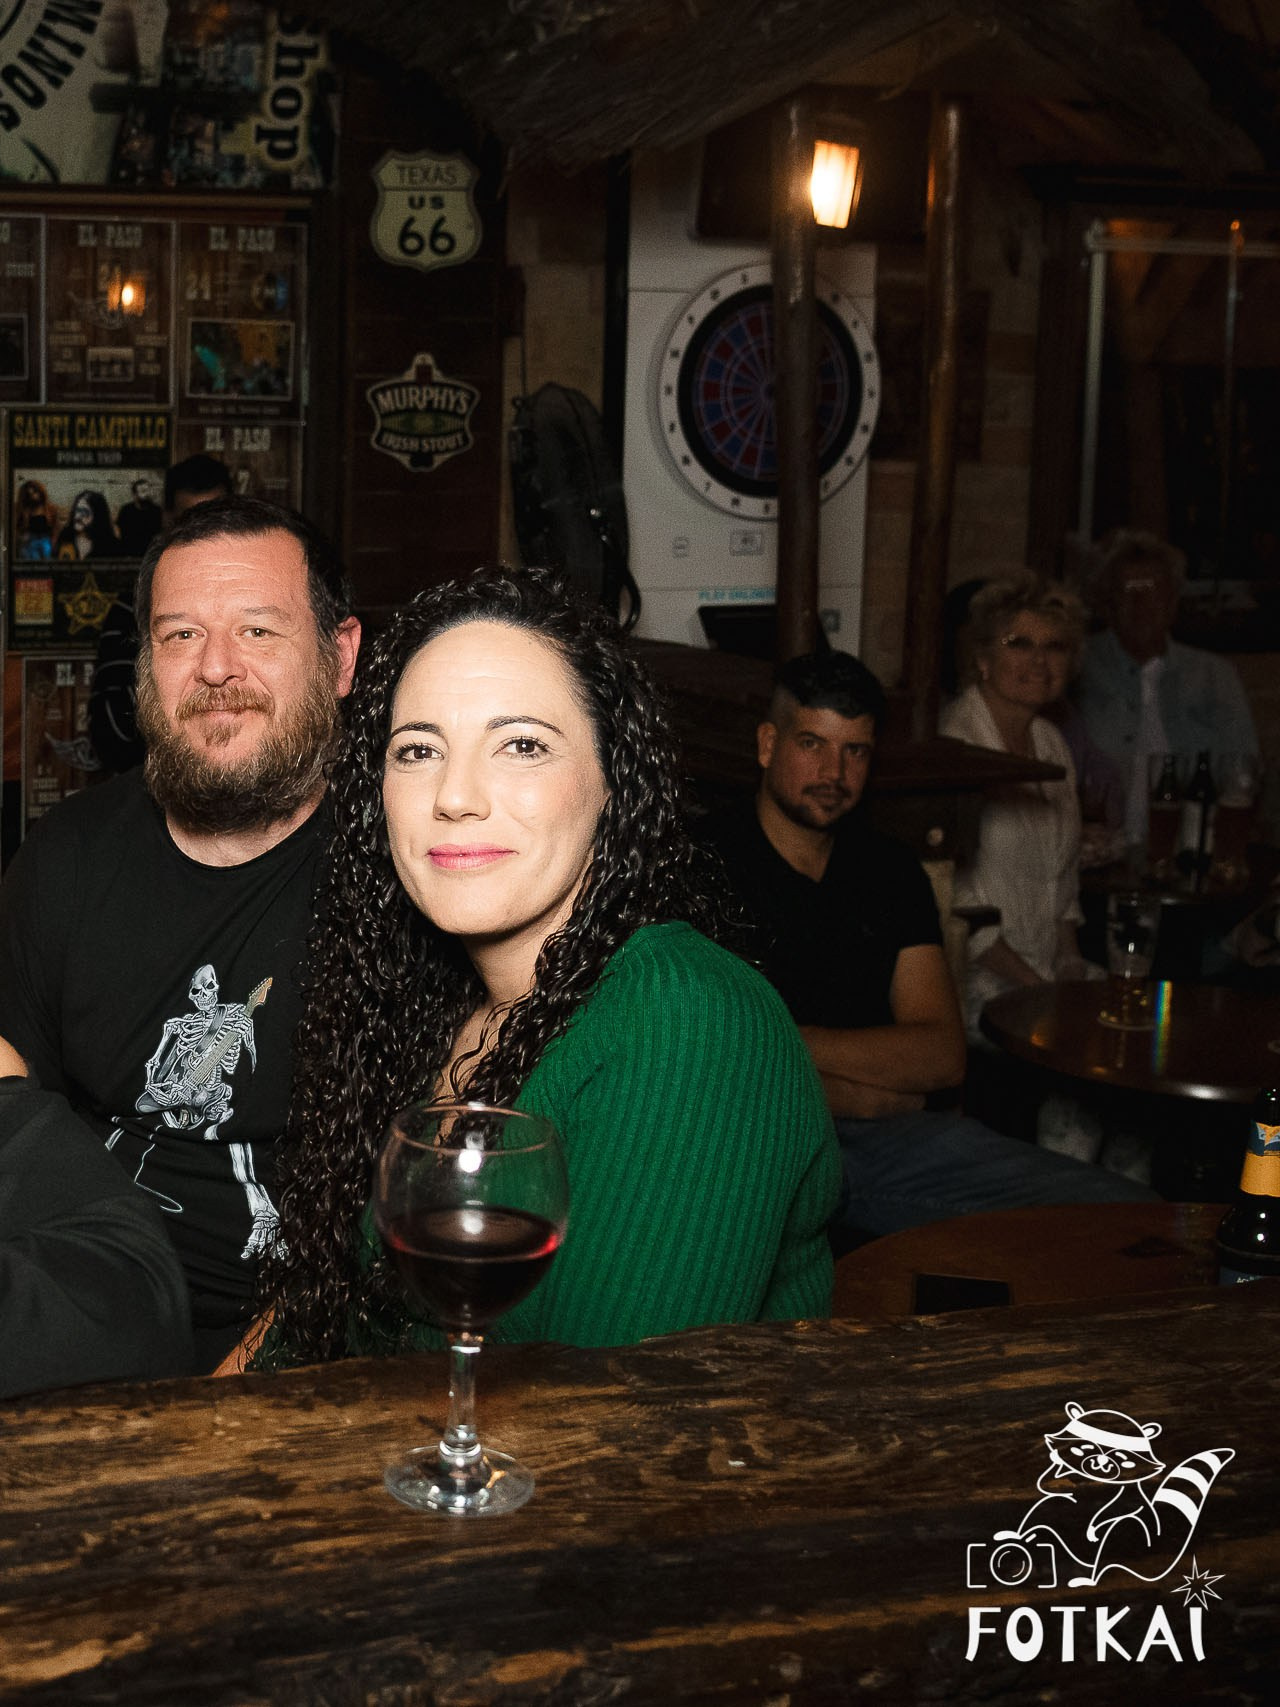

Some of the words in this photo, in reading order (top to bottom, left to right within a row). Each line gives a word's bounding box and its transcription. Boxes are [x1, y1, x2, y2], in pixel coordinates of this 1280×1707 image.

[396, 165, 457, 185] TEXAS
[78, 224, 98, 247] EL
[106, 225, 142, 249] PASO
[209, 227, 230, 251] EL
[237, 228, 276, 253] PASO
[399, 217, 455, 255] 66
[14, 415, 70, 448] SANTI
[75, 415, 168, 449] CAMPILLO
[204, 426, 225, 450] EL
[233, 427, 271, 451] PASO
[422, 432, 465, 453] STOUT
[56, 663, 76, 687] EL
